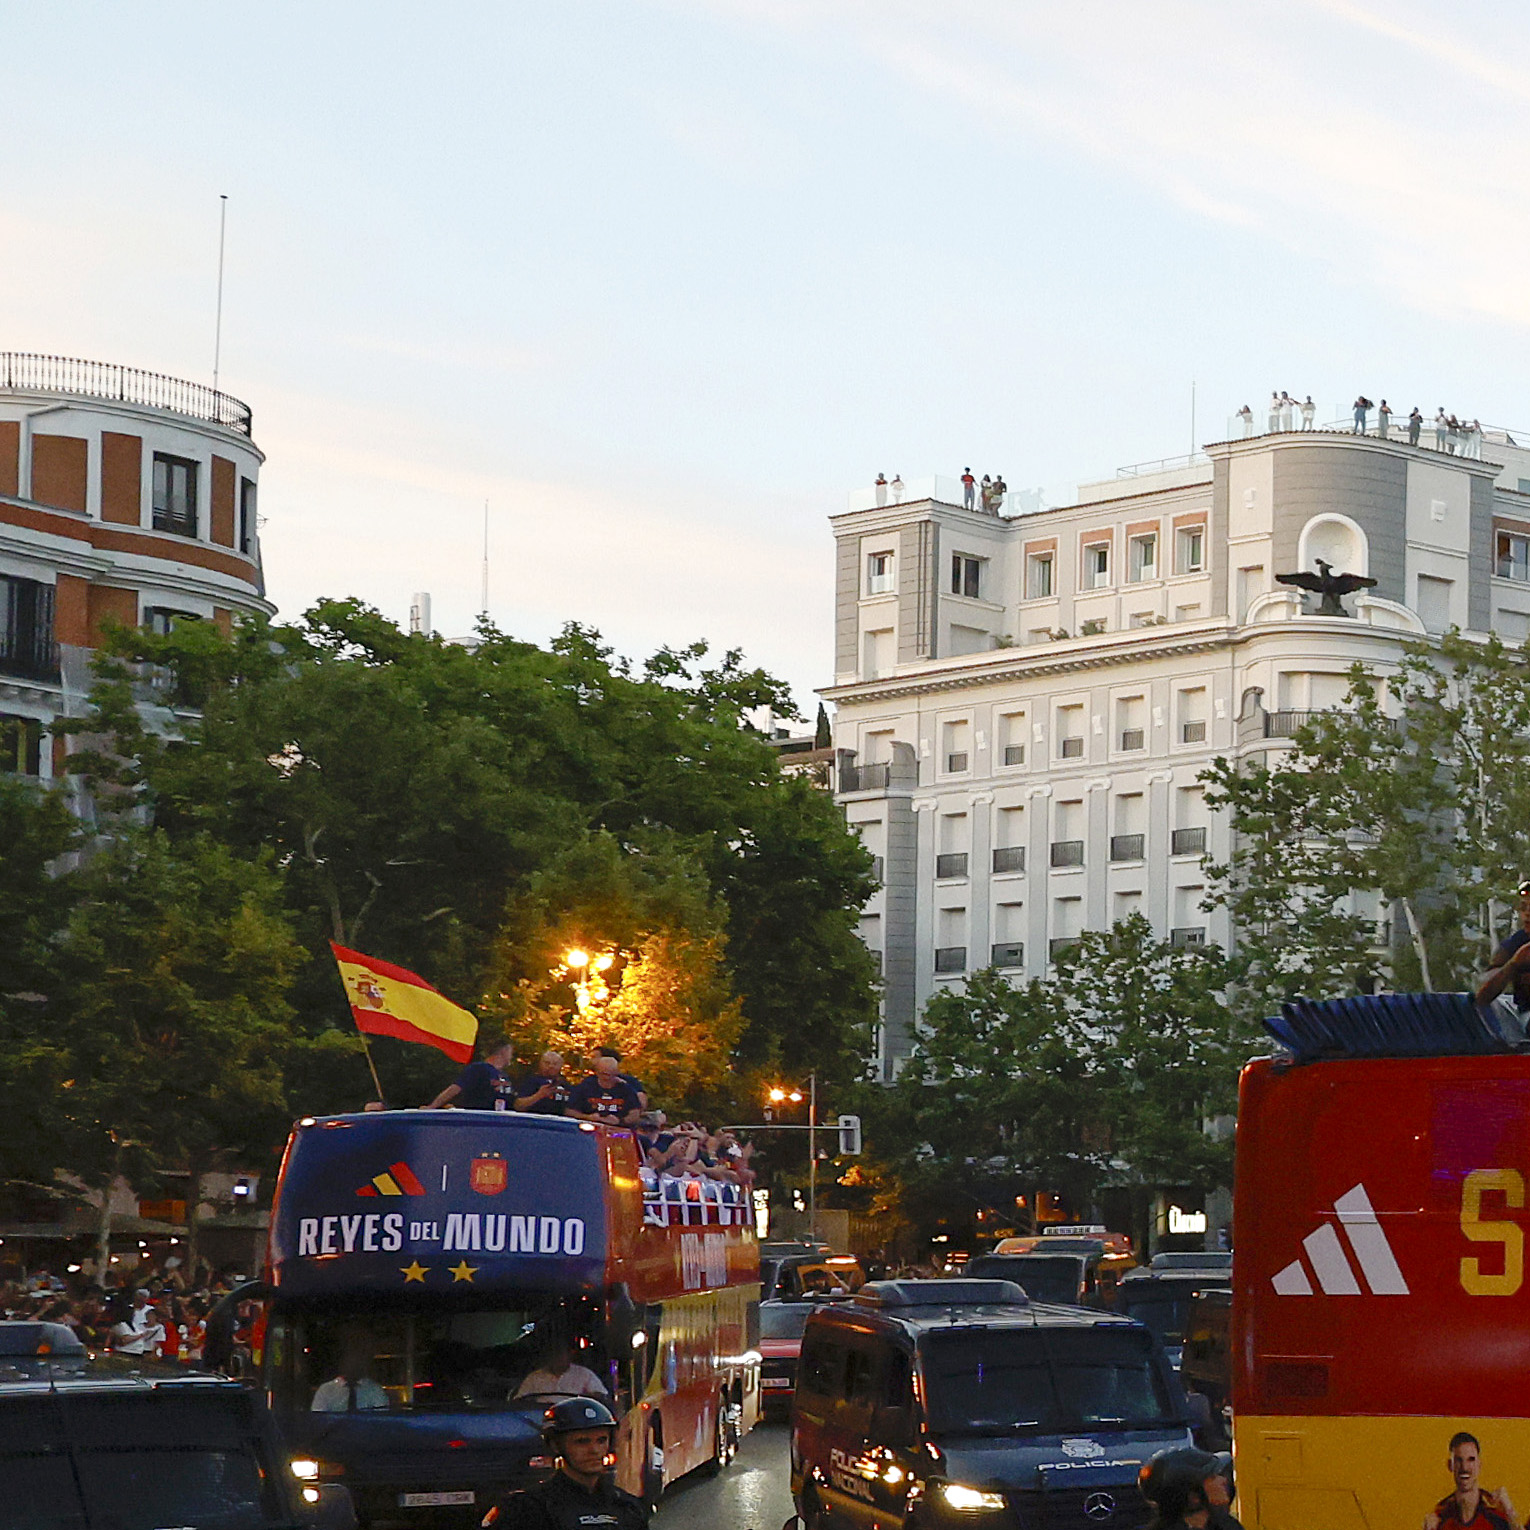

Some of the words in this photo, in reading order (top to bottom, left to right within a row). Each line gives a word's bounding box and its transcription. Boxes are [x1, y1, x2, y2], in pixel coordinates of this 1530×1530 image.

[299, 1213, 404, 1256] REYES
[409, 1221, 440, 1242] DEL
[444, 1212, 585, 1256] MUNDO
